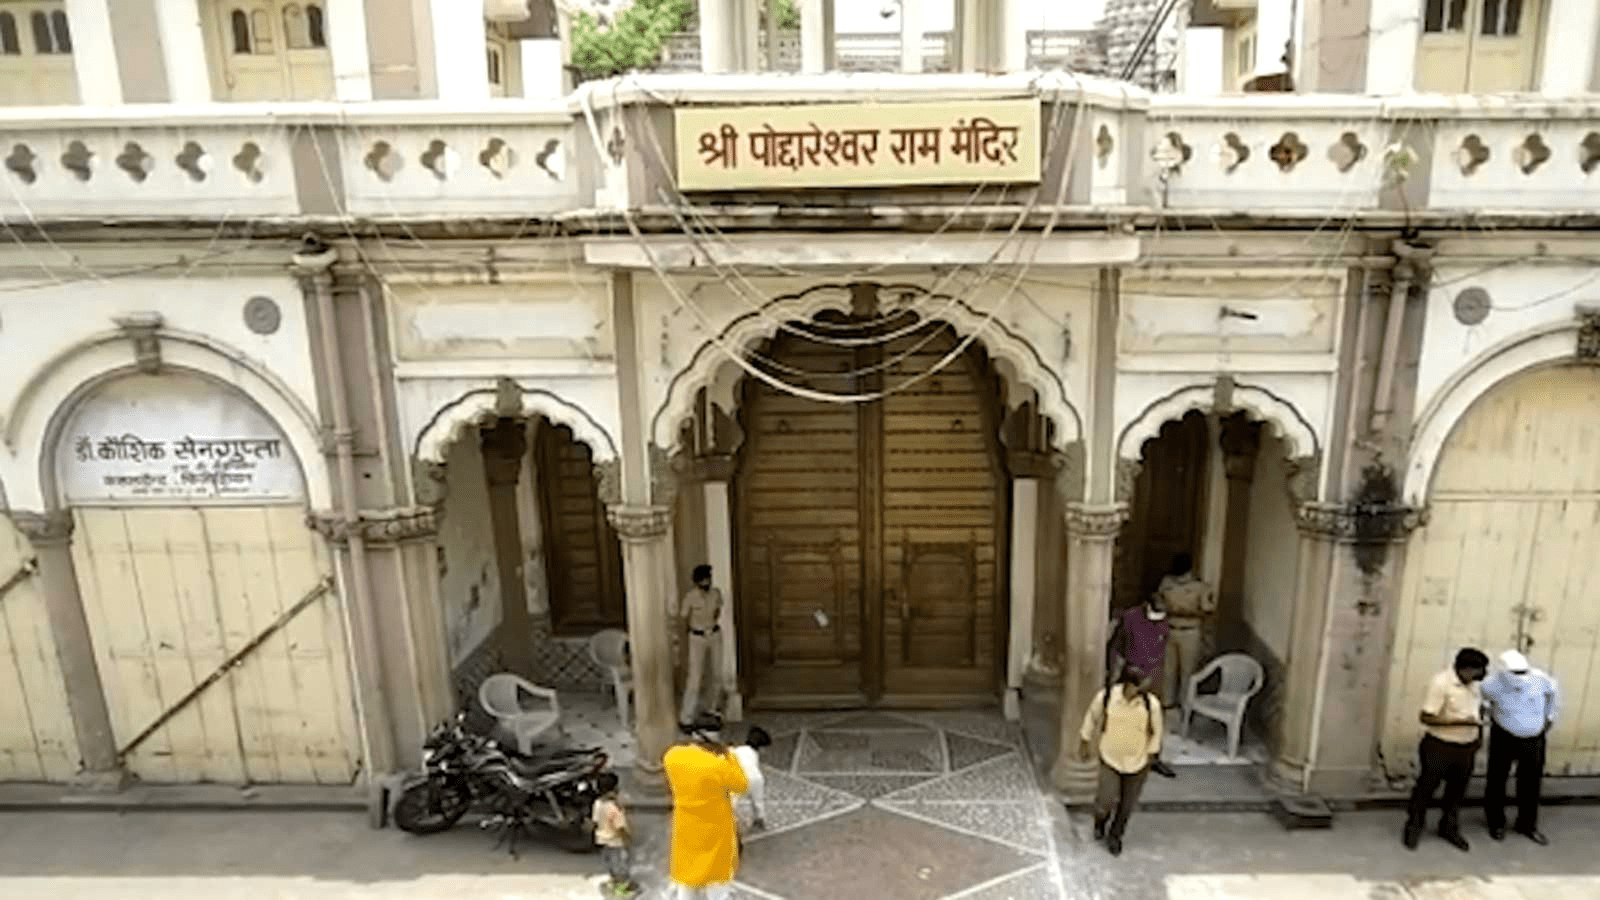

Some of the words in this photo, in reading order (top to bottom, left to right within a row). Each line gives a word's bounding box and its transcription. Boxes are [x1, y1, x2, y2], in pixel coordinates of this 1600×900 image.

[699, 123, 738, 168] श्री
[749, 122, 880, 171] पोद्दारेश्वर
[891, 126, 942, 165] राम
[951, 117, 1020, 166] मंदिर
[174, 435, 281, 464] सेनगुप्ता
